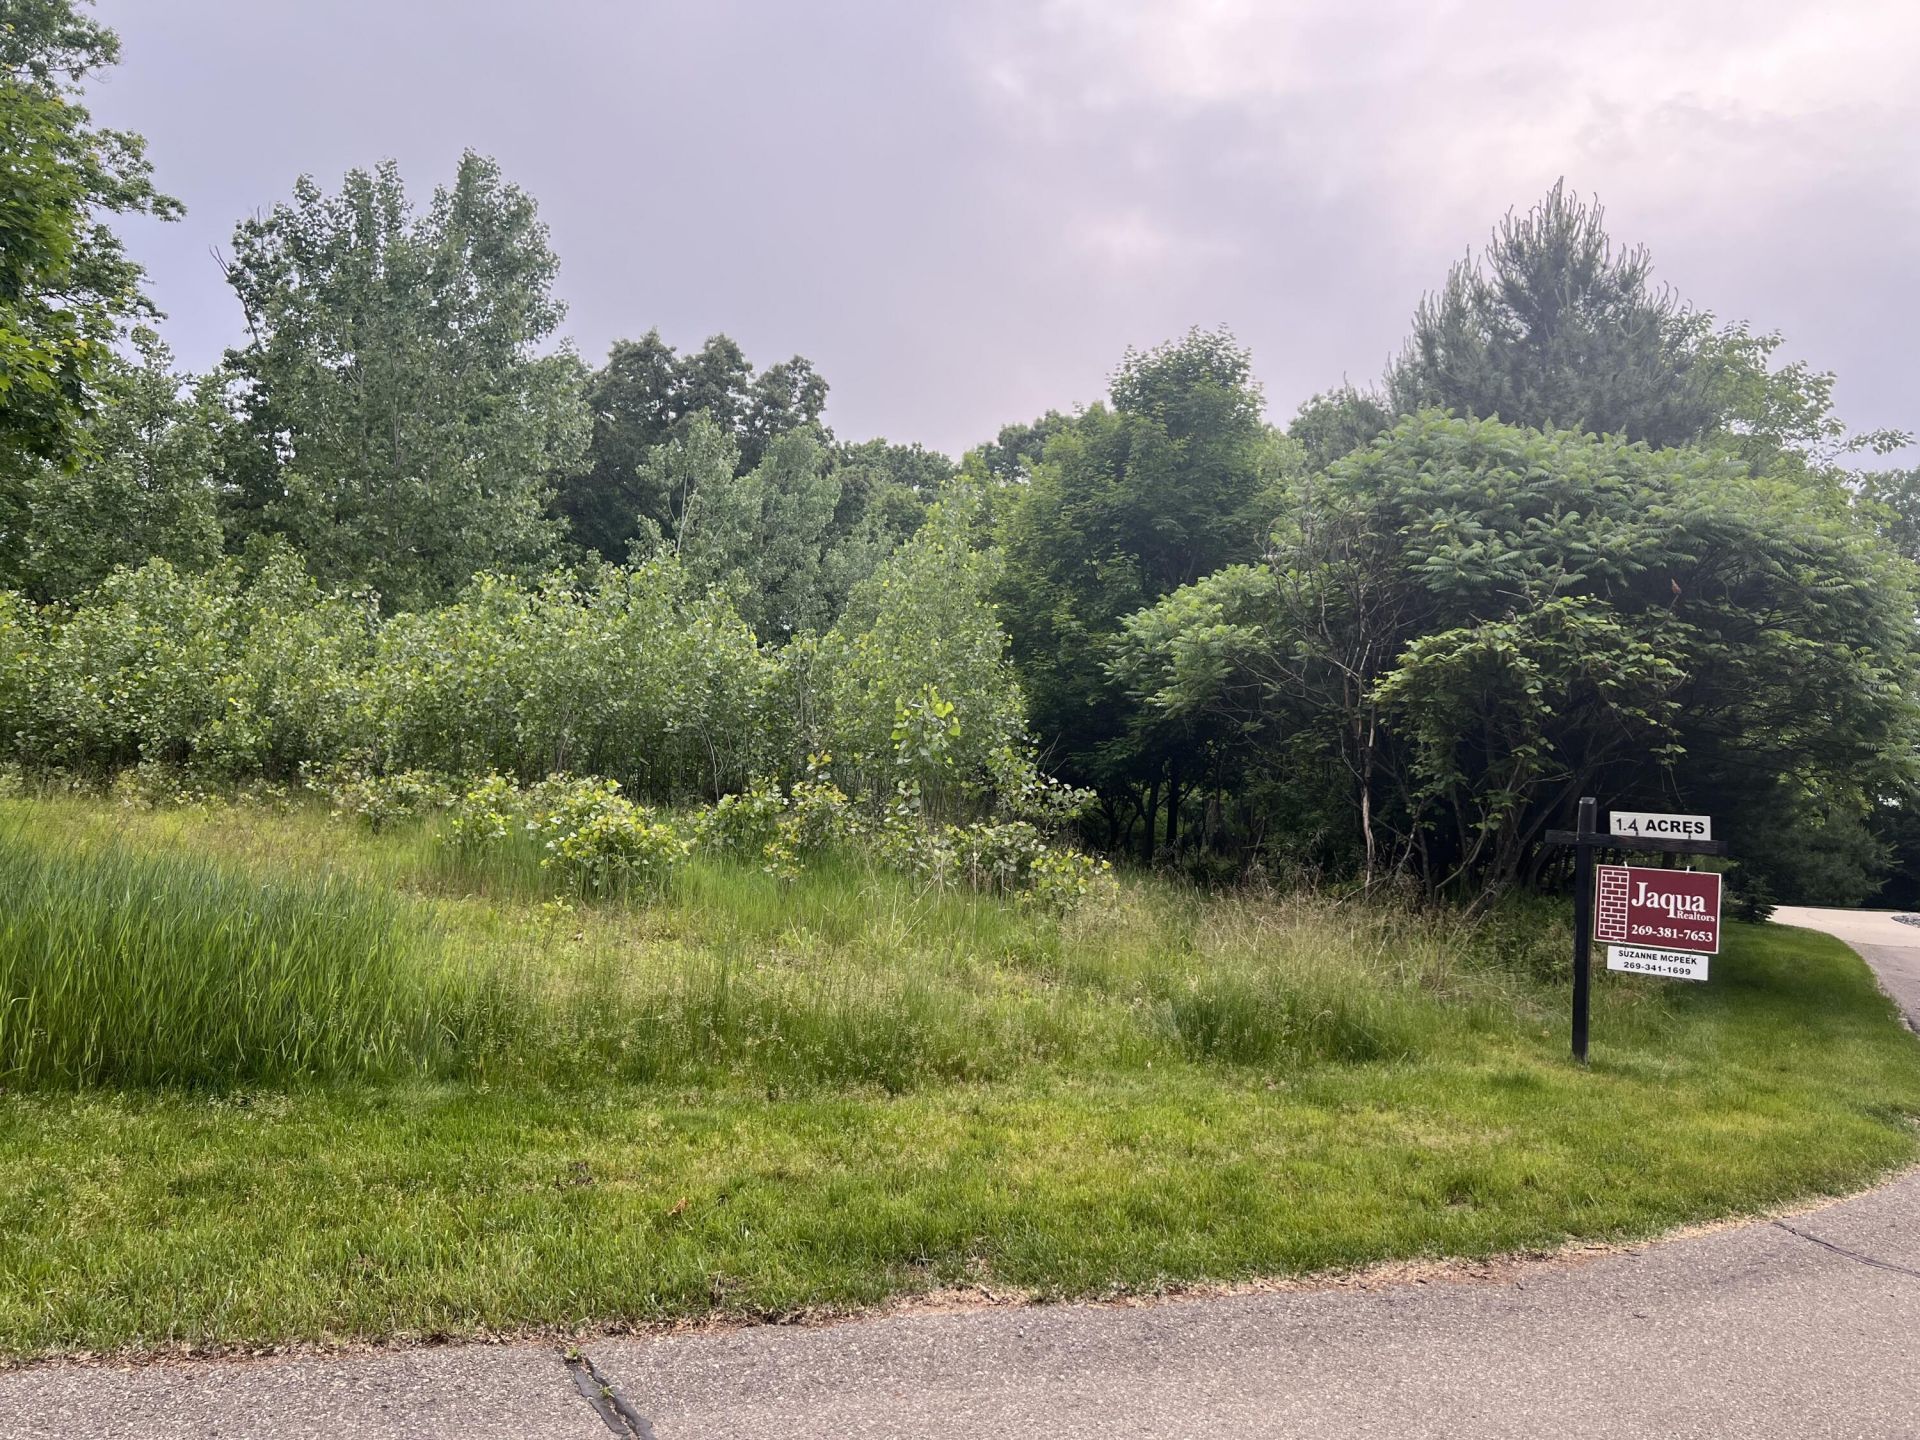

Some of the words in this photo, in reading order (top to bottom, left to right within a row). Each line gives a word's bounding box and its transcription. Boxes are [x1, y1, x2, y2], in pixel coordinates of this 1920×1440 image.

[1616, 818, 1639, 832] 1.4
[1645, 819, 1705, 834] ACRES
[1631, 881, 1706, 918] Jaqua
[1677, 910, 1716, 922] Realtors
[1631, 924, 1713, 942] 269-381-7653
[1618, 949, 1658, 961] SUZANNE
[1659, 954, 1697, 965] MCPEEK
[1623, 961, 1691, 975] 269-341-1699
